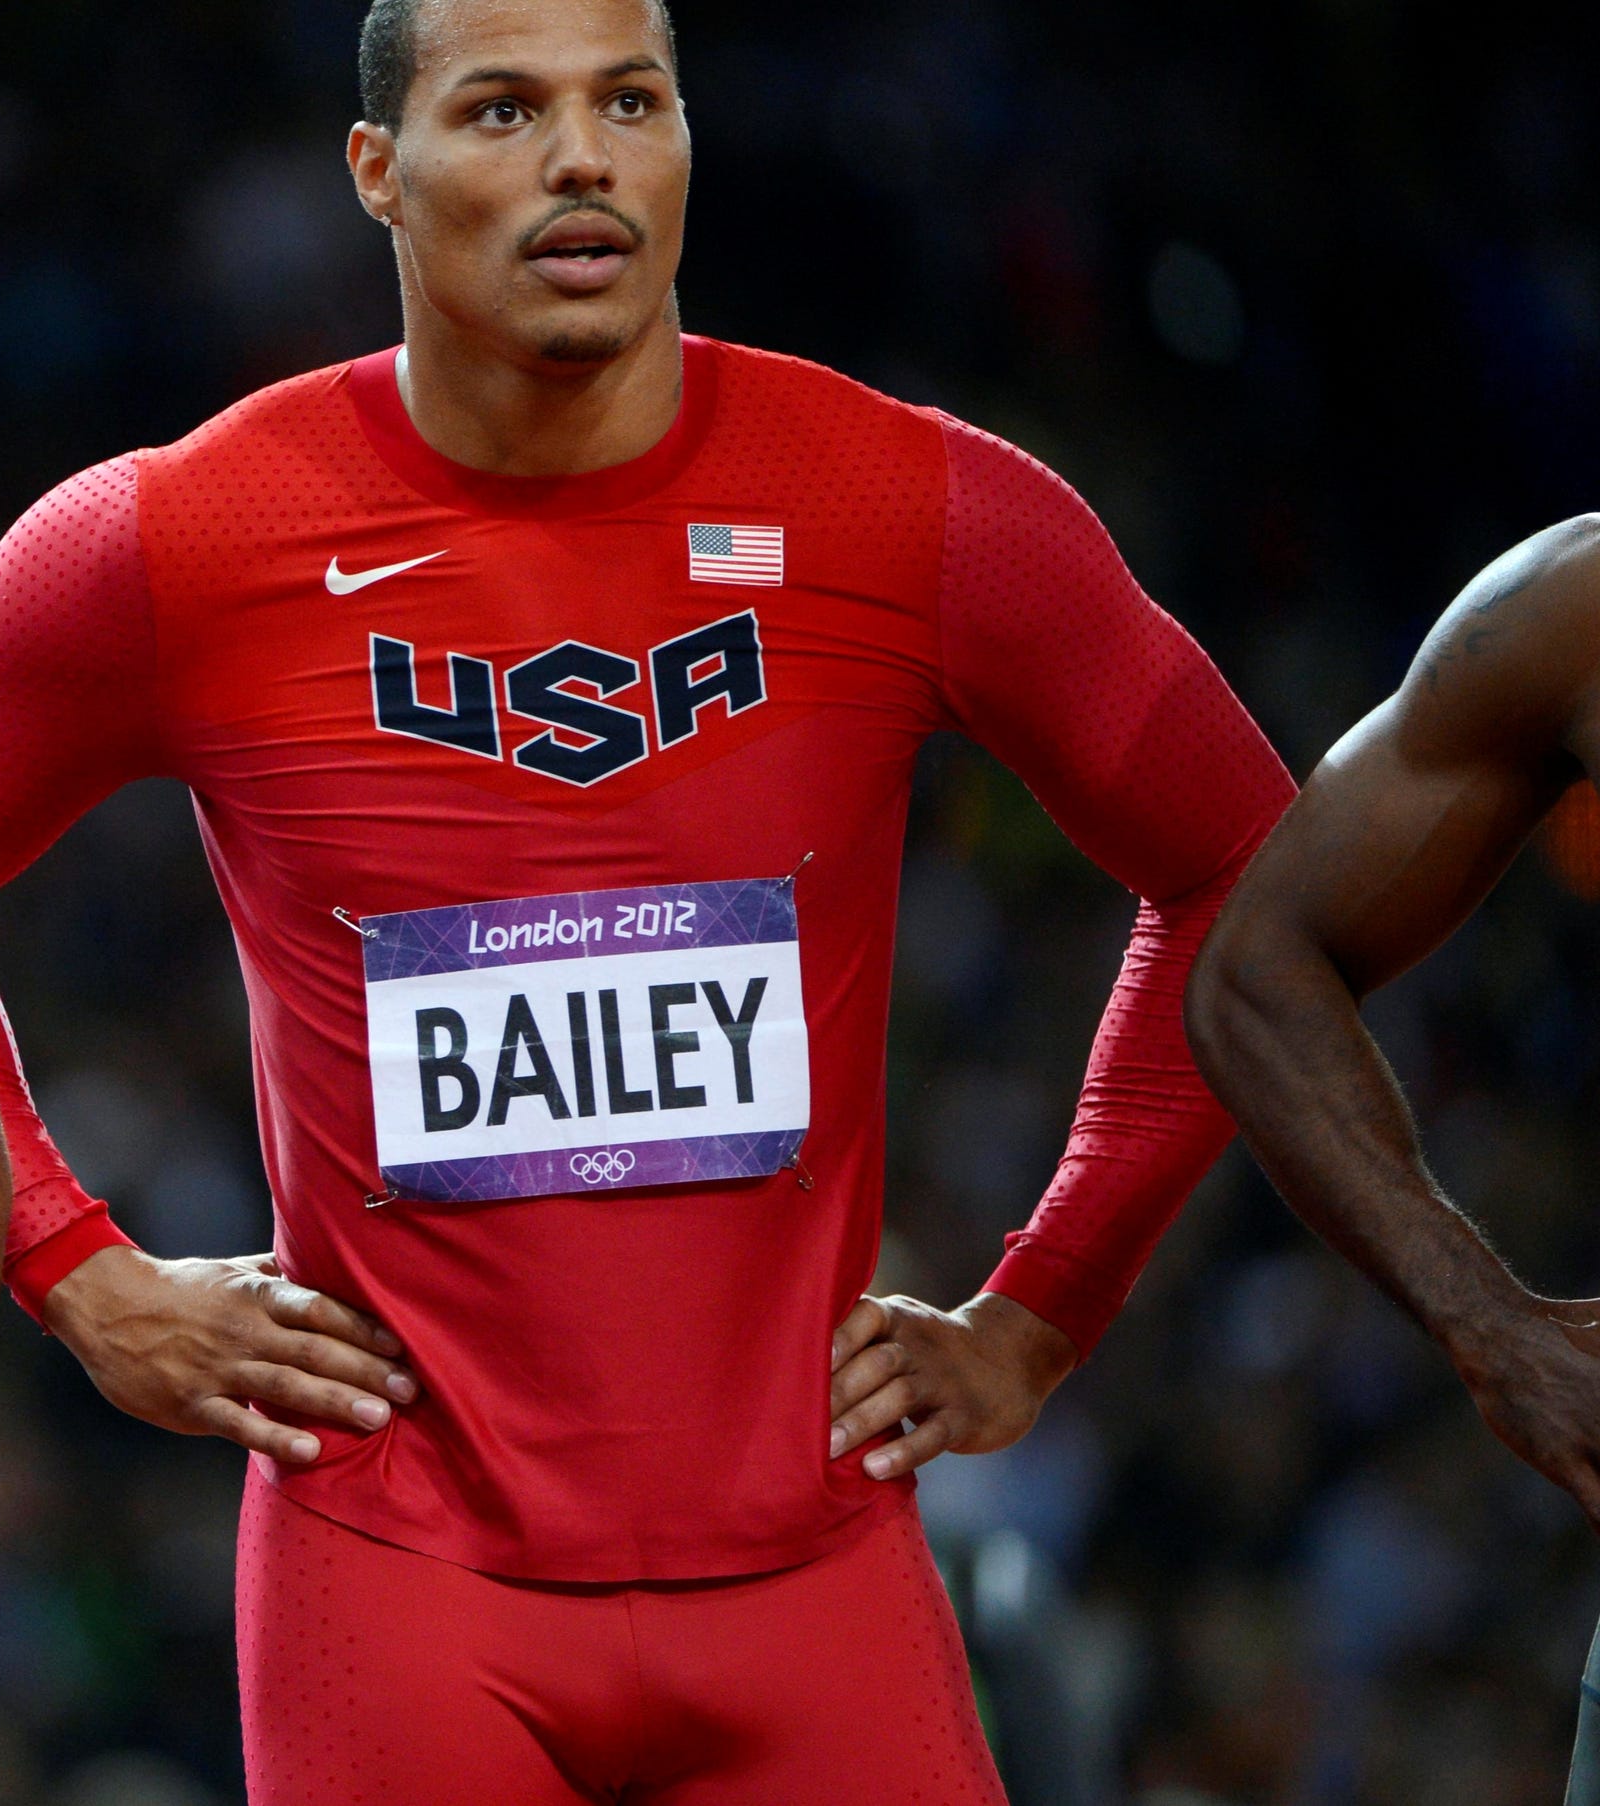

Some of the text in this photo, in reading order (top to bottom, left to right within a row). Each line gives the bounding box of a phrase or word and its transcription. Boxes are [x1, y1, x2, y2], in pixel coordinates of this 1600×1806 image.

[369, 607, 768, 788] USA
[468, 900, 697, 955] London 2012
[414, 977, 769, 1134] BAILEY
